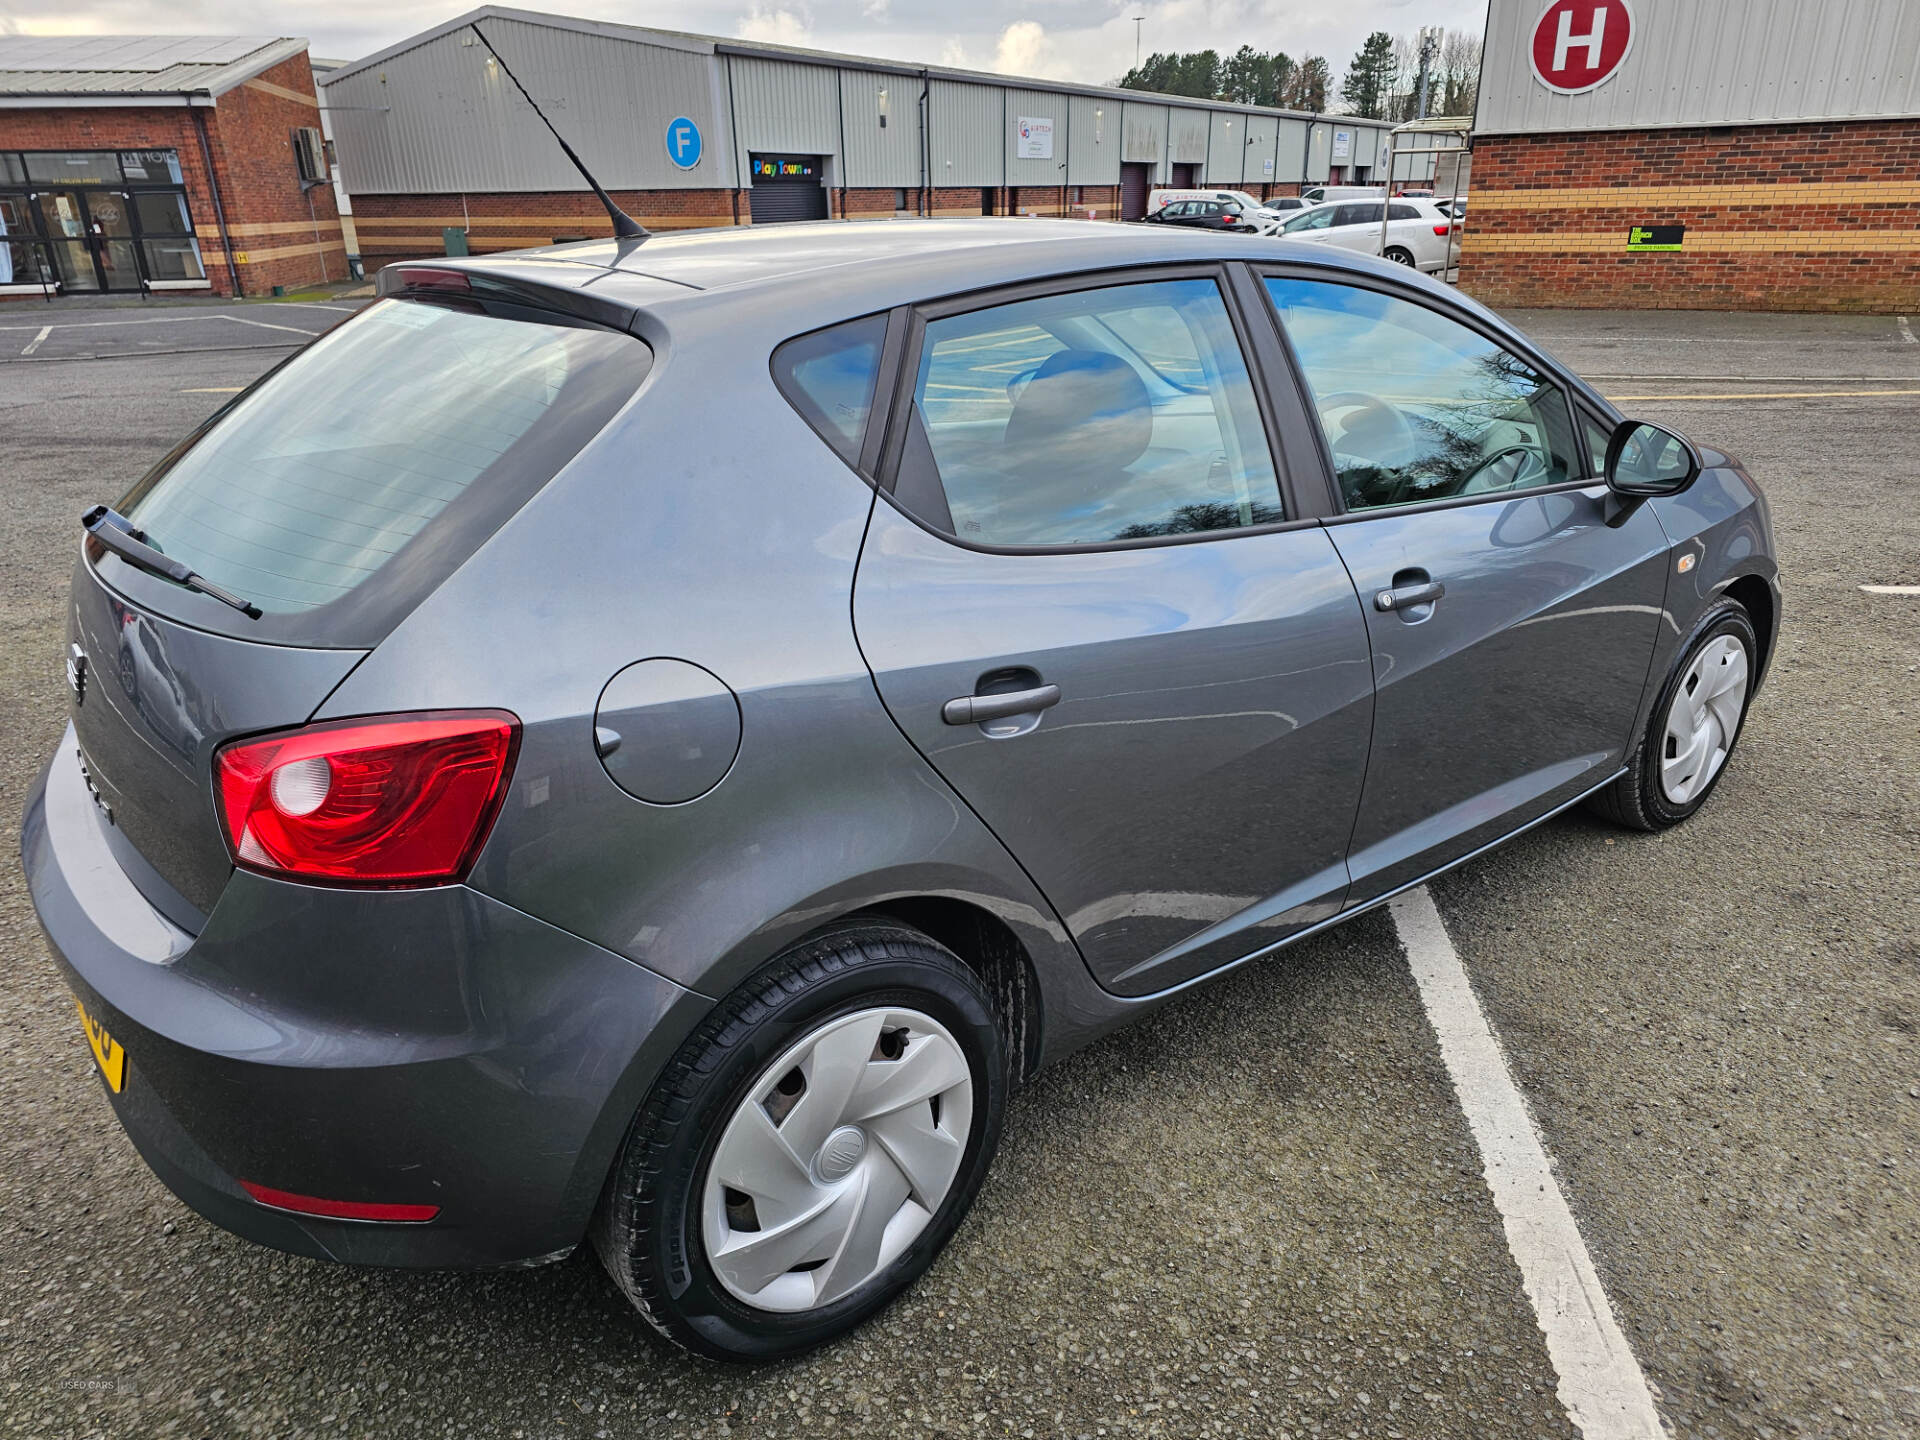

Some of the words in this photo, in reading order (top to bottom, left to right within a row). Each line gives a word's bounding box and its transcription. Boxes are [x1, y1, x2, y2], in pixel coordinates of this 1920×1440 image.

[1552, 7, 1608, 72] H
[676, 128, 690, 158] F
[753, 160, 777, 177] Play
[778, 160, 802, 175] Town
